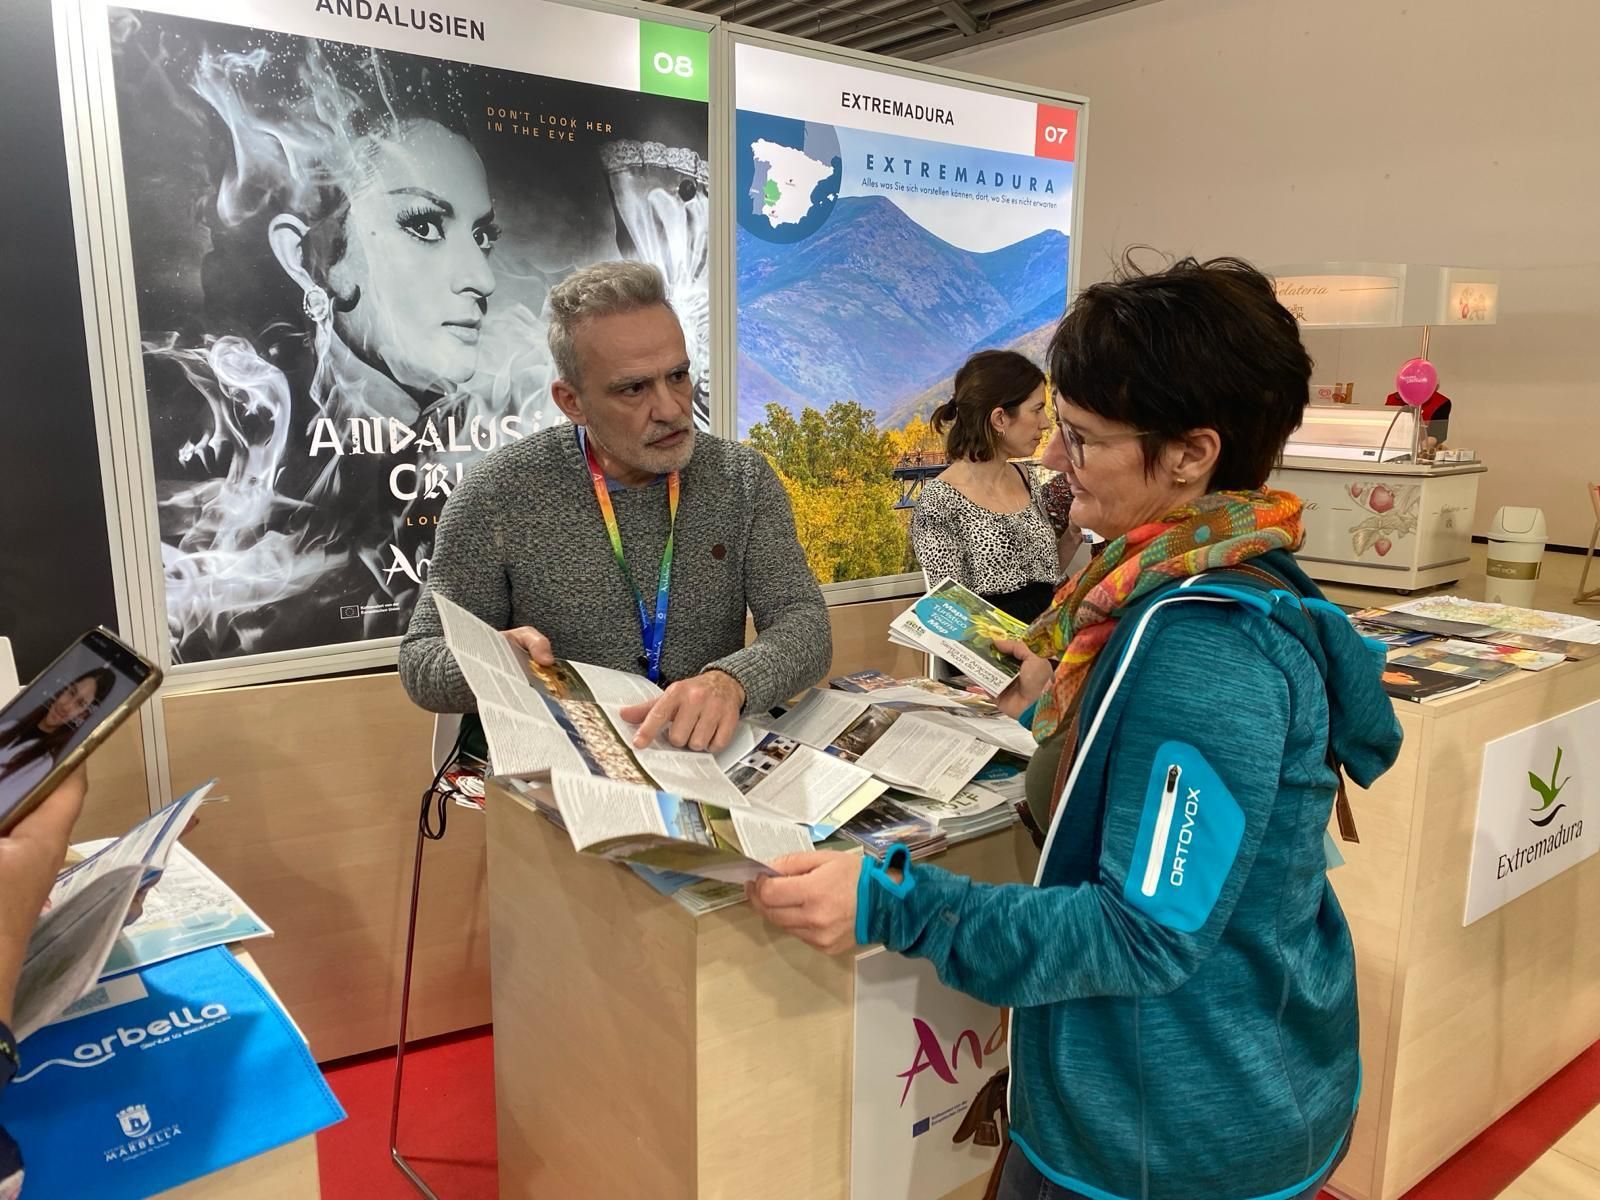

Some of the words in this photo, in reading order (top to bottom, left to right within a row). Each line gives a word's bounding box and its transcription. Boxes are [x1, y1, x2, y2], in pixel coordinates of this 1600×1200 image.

[315, 0, 486, 41] ANDALUSIEN
[653, 51, 694, 78] 08
[487, 106, 530, 122] DON'T
[540, 114, 578, 129] LOOK
[586, 121, 613, 134] HER
[841, 91, 955, 126] EXTREMADURA
[487, 122, 502, 133] IN
[512, 125, 540, 138] THE
[548, 130, 575, 142] EYE
[1044, 126, 1068, 145] 07
[866, 153, 1055, 194] EXTREMADURA
[861, 177, 879, 188] Alles
[880, 182, 893, 190] was
[894, 181, 905, 192] Sie
[906, 183, 919, 193] sich
[919, 186, 949, 197] vorstellen
[1001, 194, 1010, 204] Sie
[1018, 197, 1032, 206] nicht
[1032, 200, 1057, 209] erwarten
[927, 619, 949, 634] Map
[930, 612, 958, 632] Tourist
[942, 602, 968, 621] Mapa
[1170, 787, 1201, 887] ORTOVOX
[1496, 819, 1584, 880] Extremadura
[105, 1126, 182, 1162] MARBELLA
